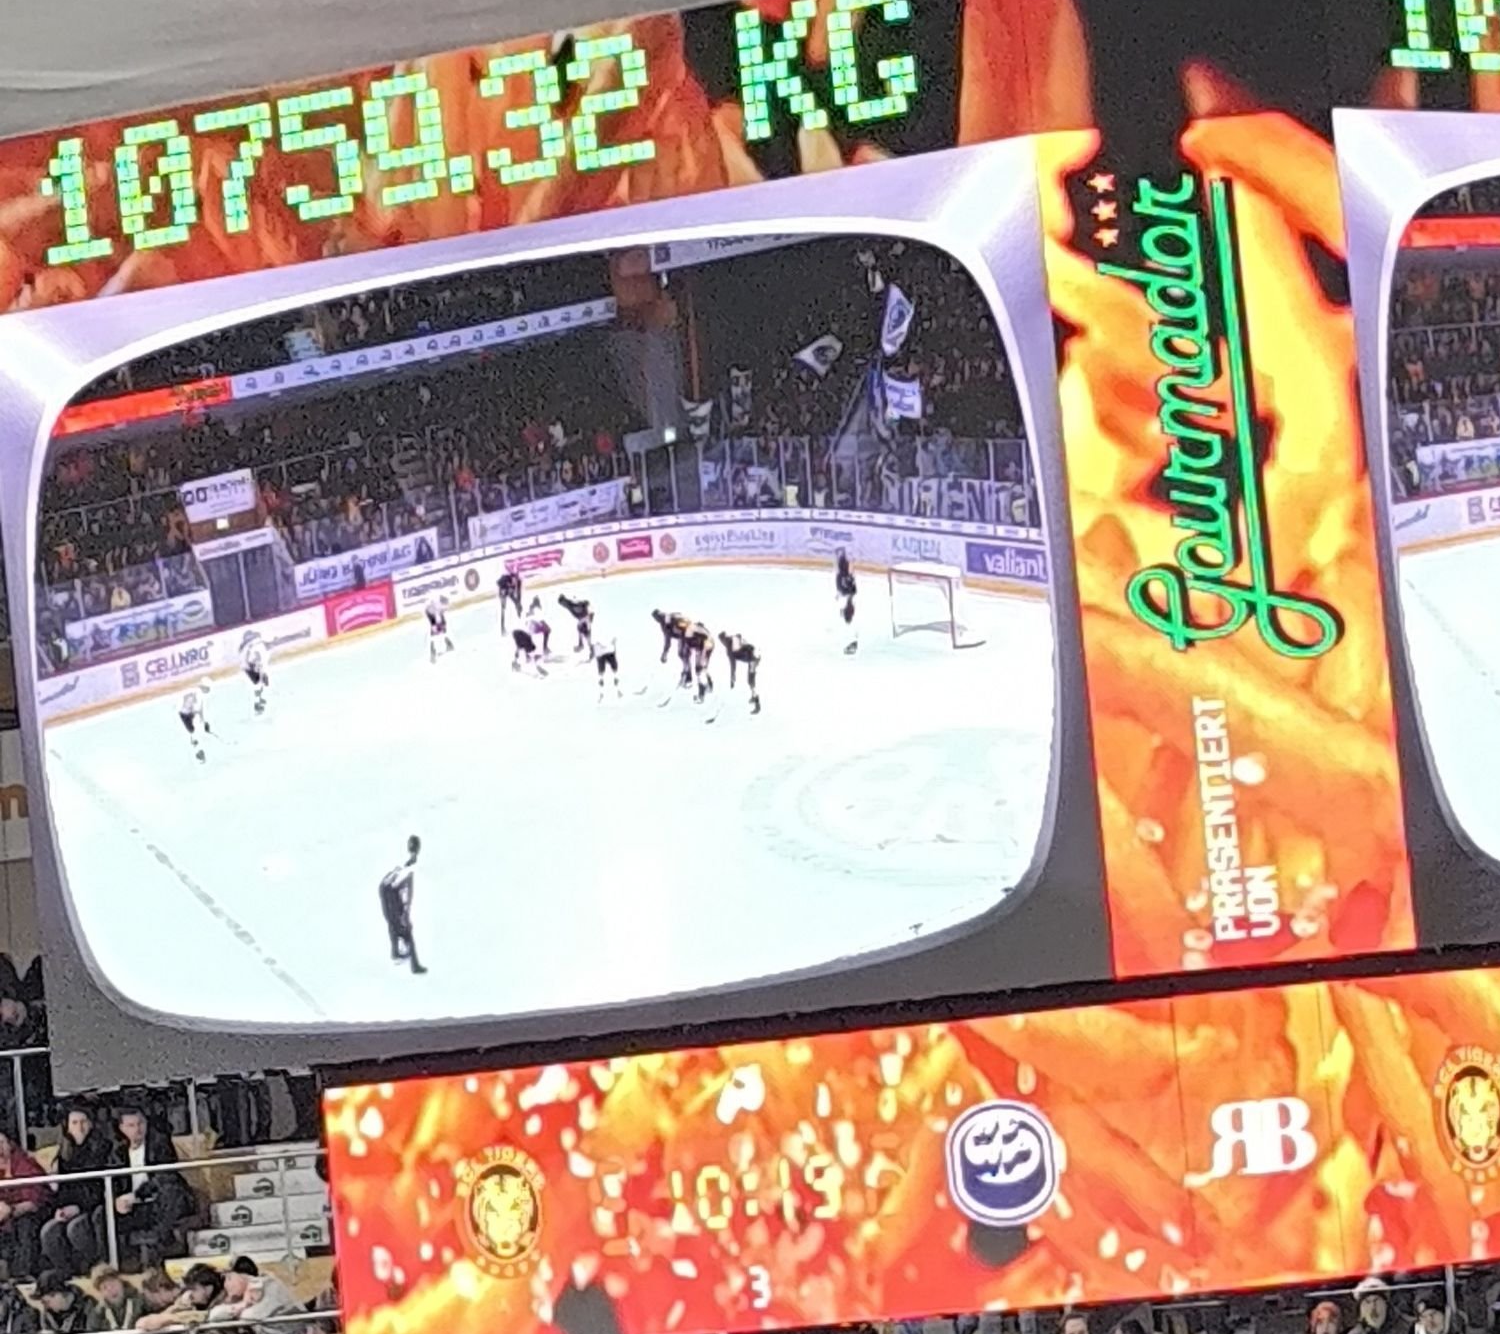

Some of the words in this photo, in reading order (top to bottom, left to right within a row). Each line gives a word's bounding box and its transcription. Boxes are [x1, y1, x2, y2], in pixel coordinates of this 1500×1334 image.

[41, 33, 655, 264] 10759.32
[1098, 172, 1343, 659] Gourmador
[749, 1264, 772, 1309] 3
